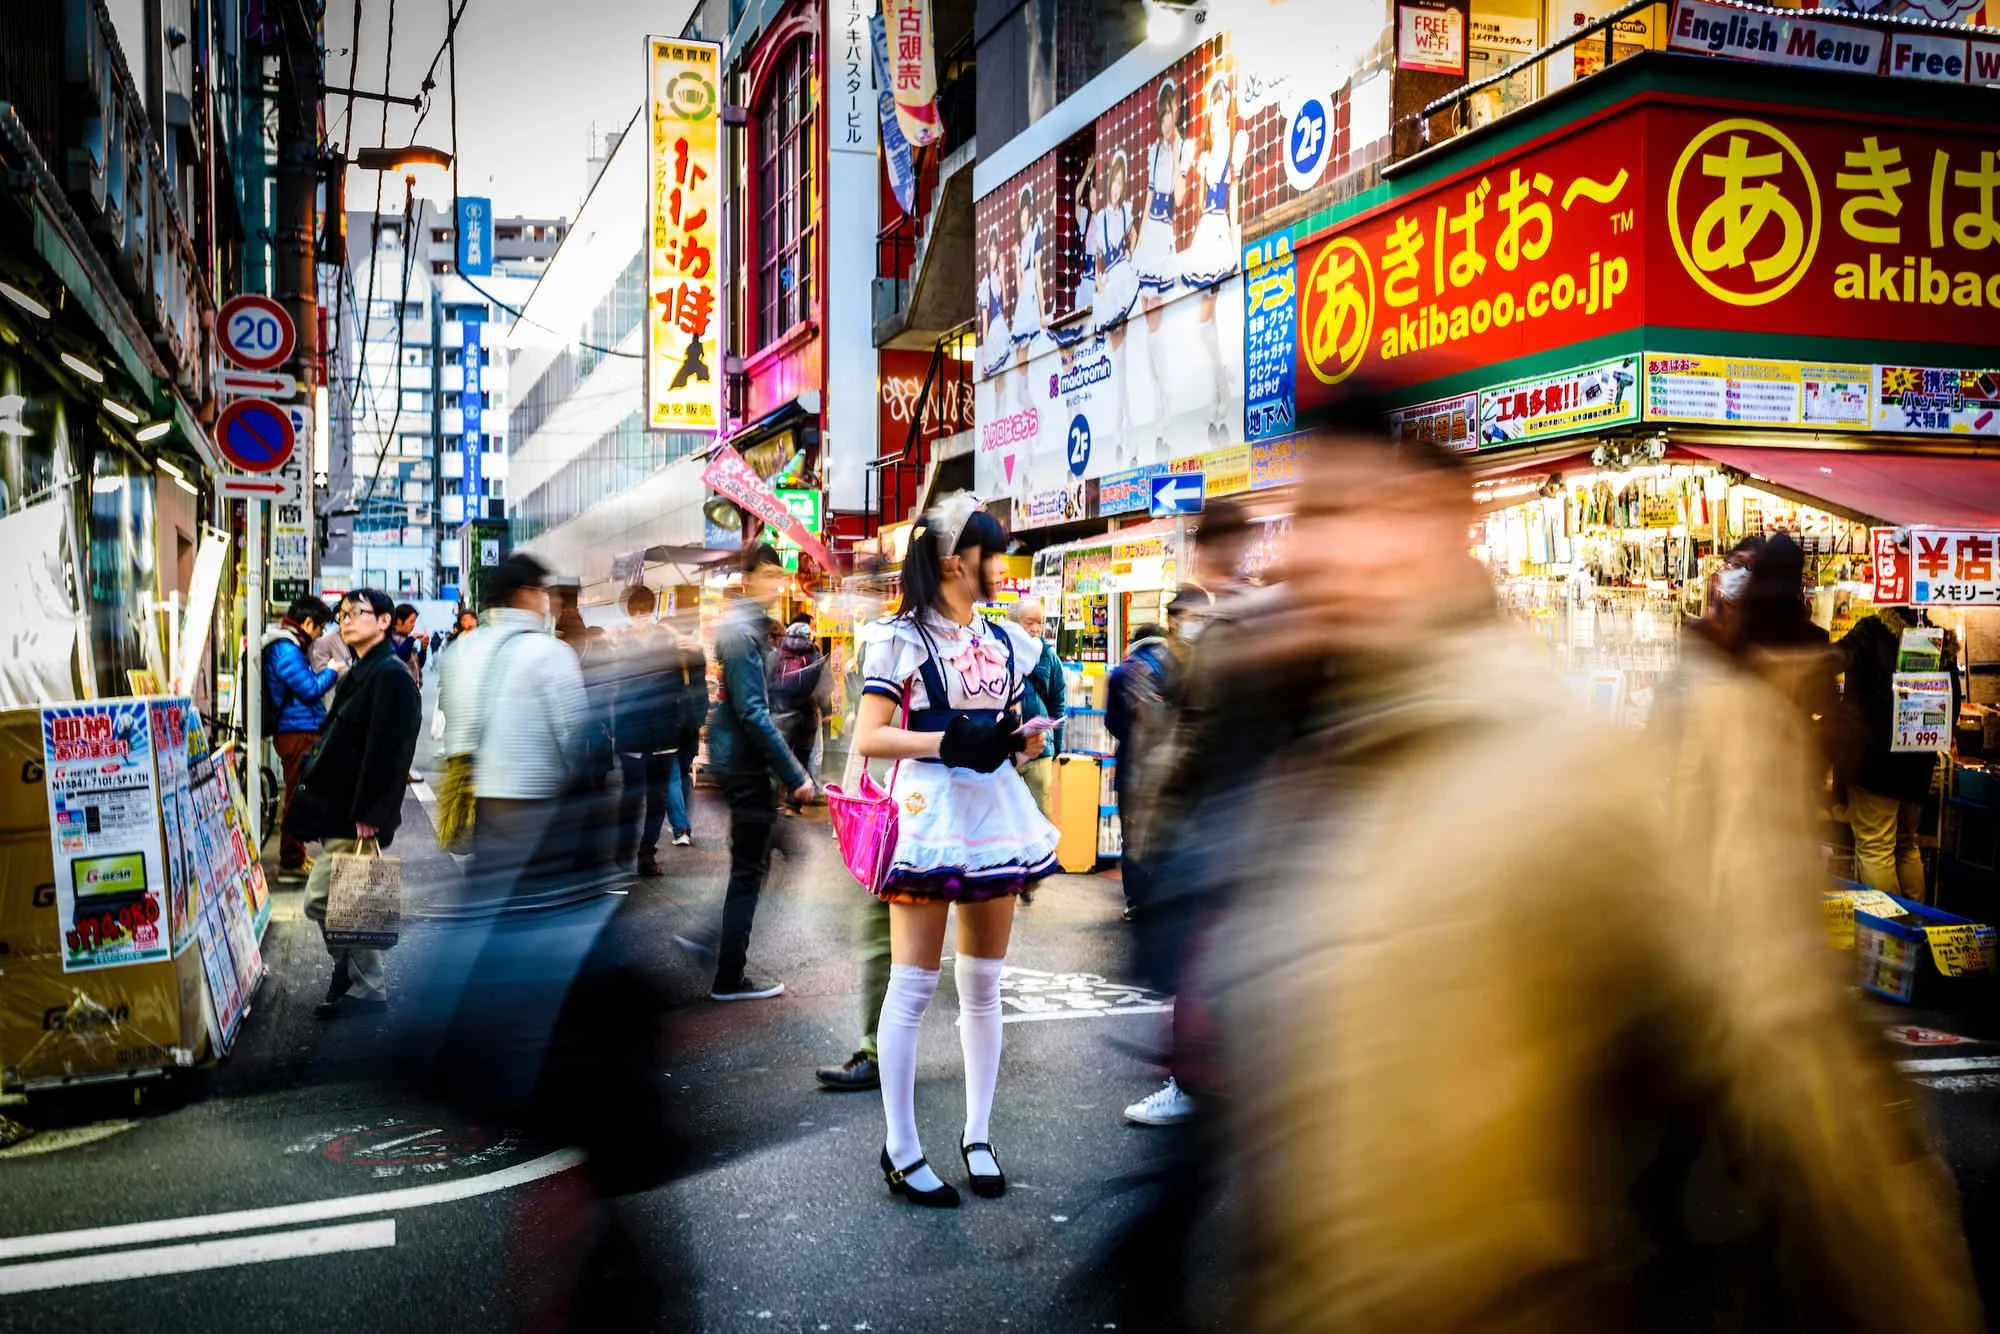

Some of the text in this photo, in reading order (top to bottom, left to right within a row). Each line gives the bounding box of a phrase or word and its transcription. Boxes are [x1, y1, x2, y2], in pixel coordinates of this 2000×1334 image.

[1414, 15, 1449, 33] FREE
[1415, 33, 1449, 51] Wi-Fi
[1676, 8, 1870, 67] English Menu
[1894, 43, 1963, 77] Free
[1294, 116, 1323, 165] 2F
[1691, 135, 1804, 284] あ
[1247, 268, 1296, 318] アニメ
[1312, 253, 1367, 366] あ
[1380, 252, 1629, 360] akibaoo.co.jp
[234, 314, 279, 351] 20
[1249, 323, 1289, 351] フィギュア
[1060, 355, 1111, 394] maidreamin
[1249, 358, 1288, 383] PCゲーム
[1249, 377, 1280, 401] おみやげ
[981, 407, 1039, 454] 入り口はこちら
[1070, 427, 1089, 464] 2F
[1933, 584, 2000, 601] メモリー
